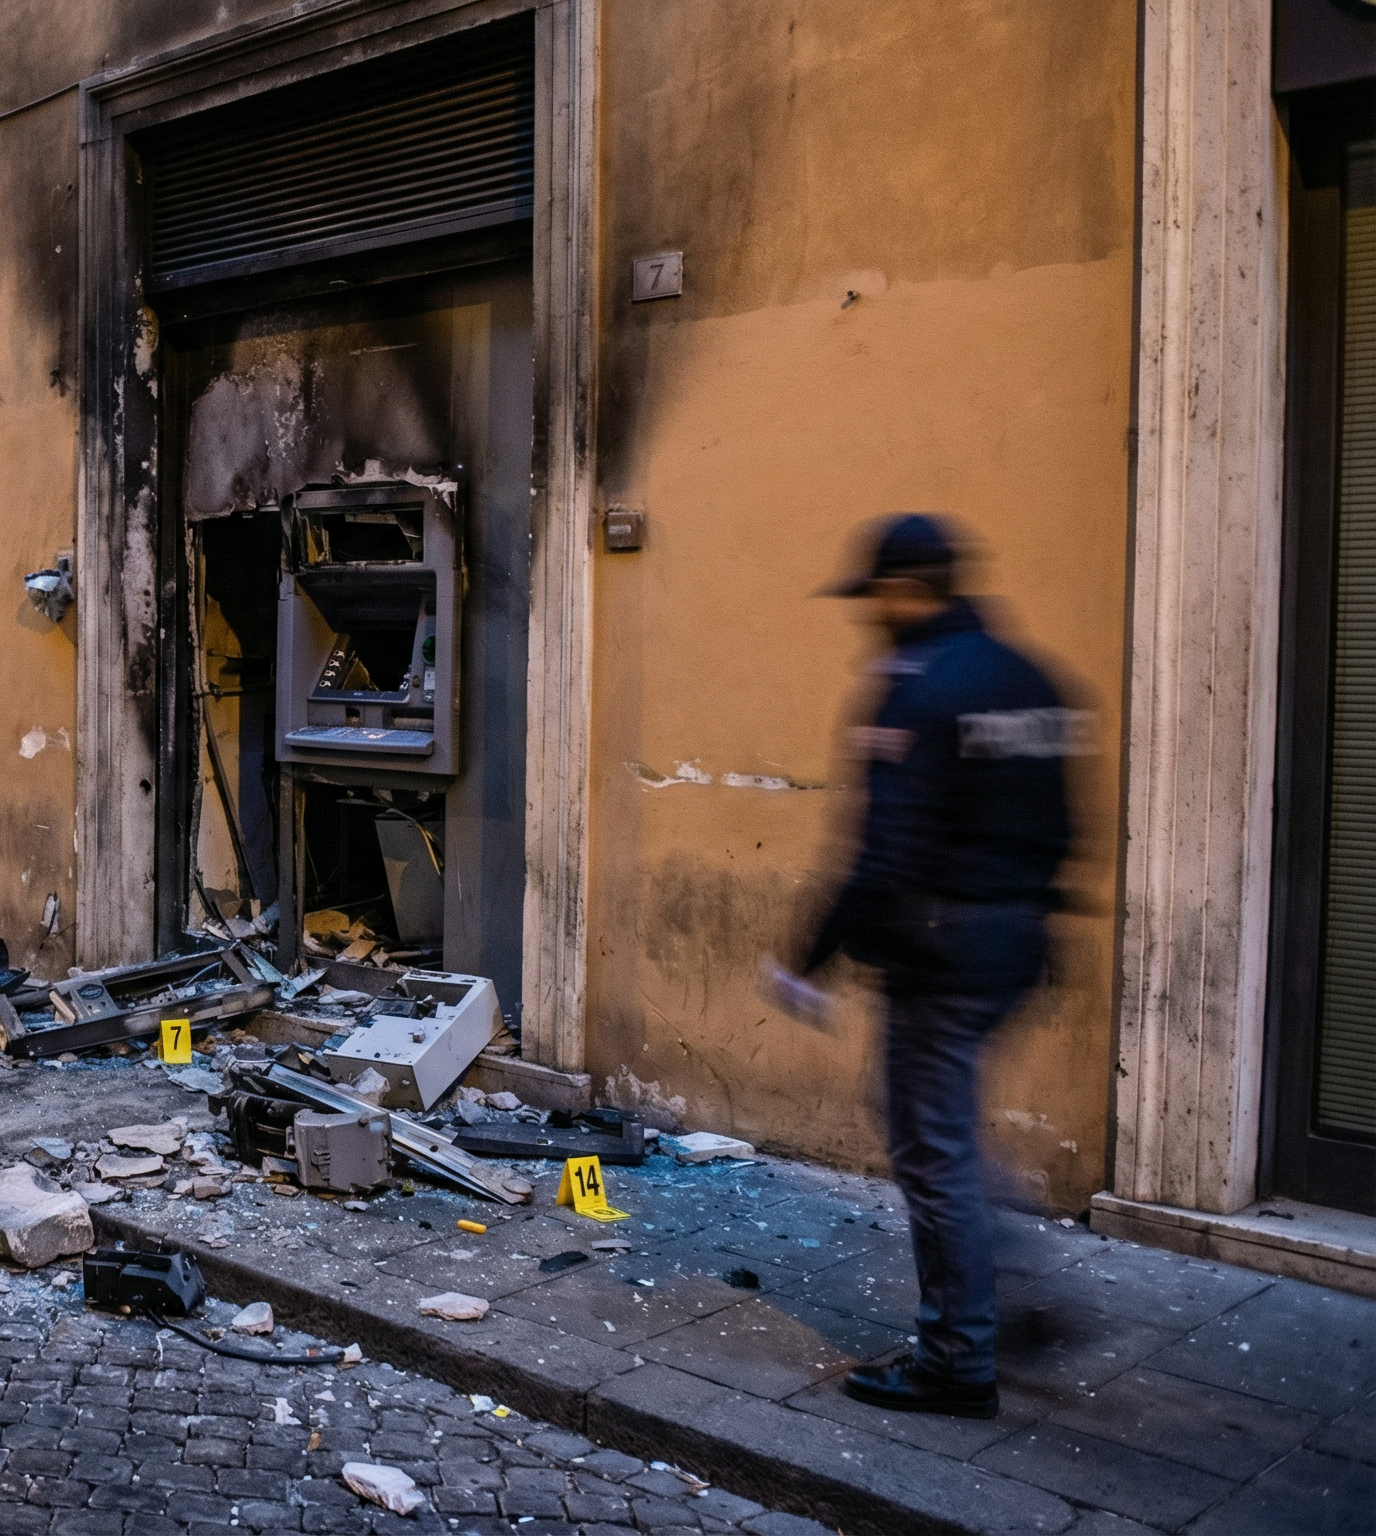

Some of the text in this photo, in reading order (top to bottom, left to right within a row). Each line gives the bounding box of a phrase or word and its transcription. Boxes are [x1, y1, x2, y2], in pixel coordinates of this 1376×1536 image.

[650, 263, 665, 291] 7
[170, 1026, 182, 1050] 7
[575, 1165, 600, 1197] 14
